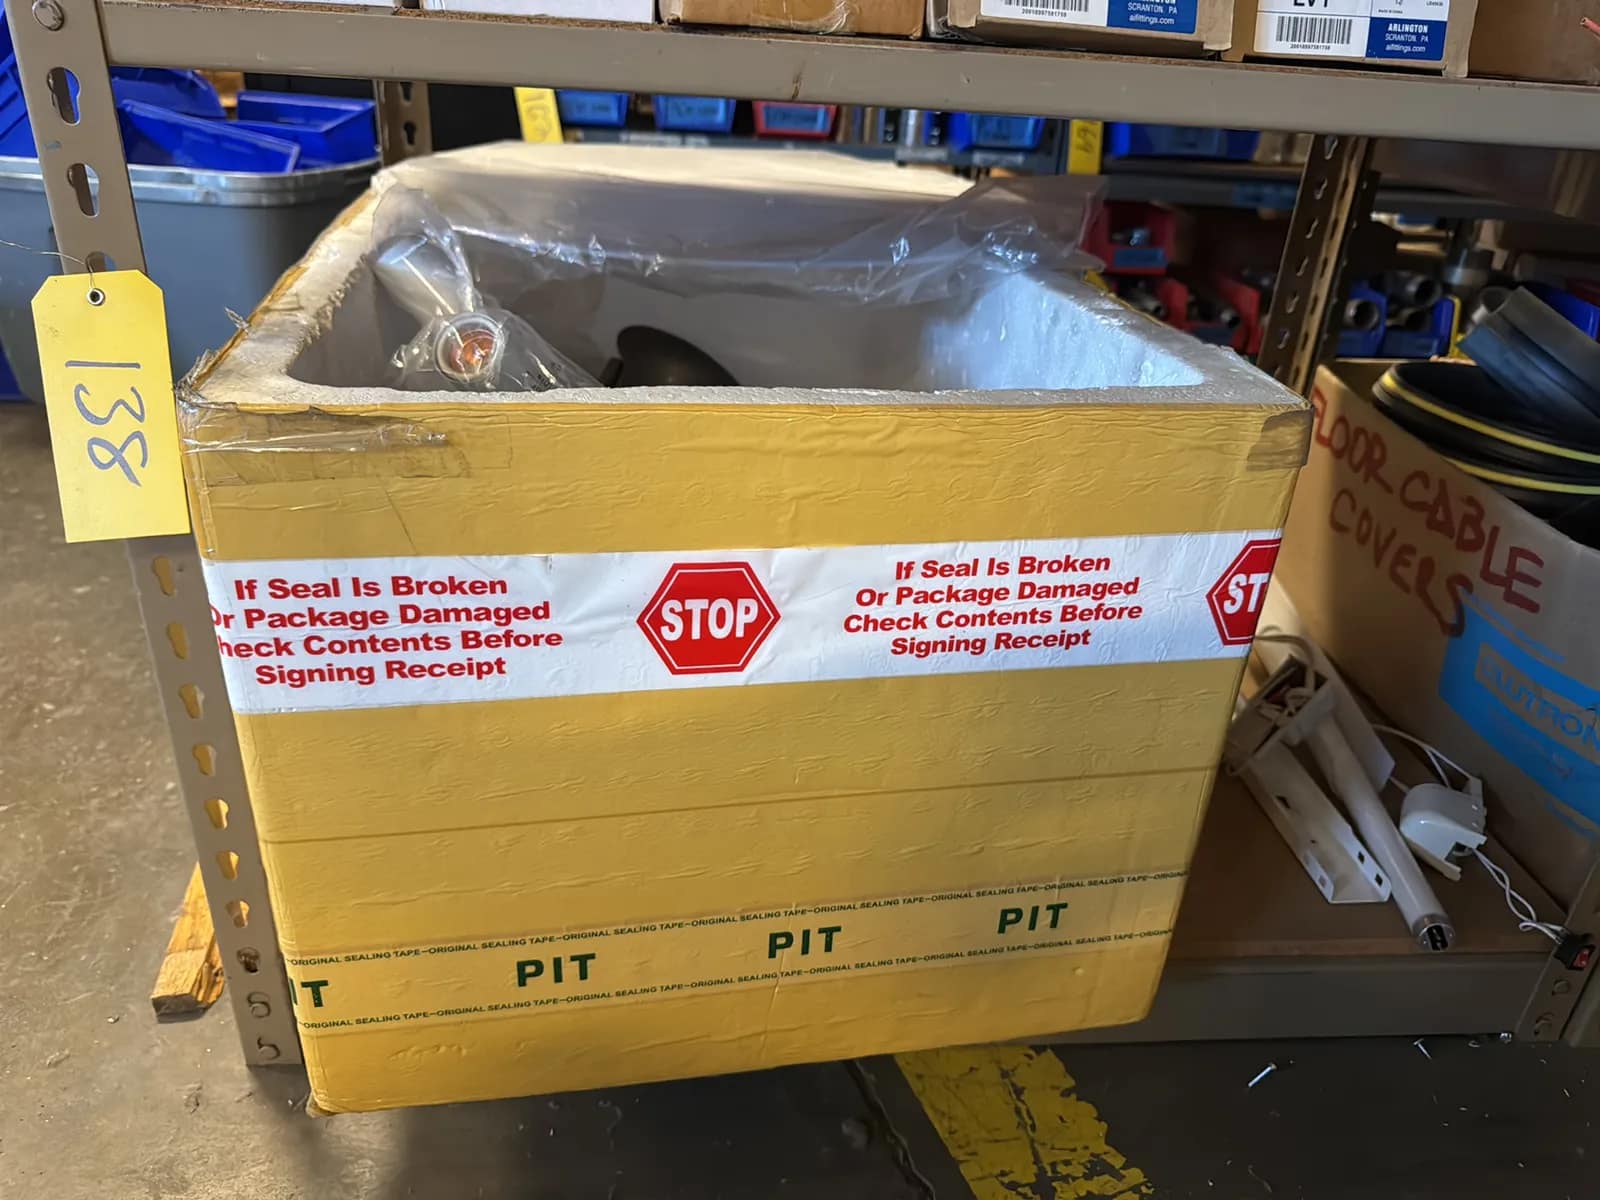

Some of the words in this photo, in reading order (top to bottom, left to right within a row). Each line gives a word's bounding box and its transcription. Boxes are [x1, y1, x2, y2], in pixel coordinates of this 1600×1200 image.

[1387, 23, 1429, 33] ARLINGTON
[65, 359, 148, 487] 138
[1398, 469, 1545, 615] CABLE
[895, 559, 917, 580] If
[921, 557, 978, 579] Seal
[987, 555, 1010, 577] Is
[1019, 554, 1111, 575] Broken
[1330, 487, 1474, 638] COVERS
[234, 579, 258, 600] If
[268, 577, 341, 600] Seal
[352, 576, 382, 597] Is
[391, 575, 508, 597] Broken
[855, 588, 890, 608] Or
[894, 583, 1010, 609] Package
[1018, 577, 1139, 602] Damaged
[243, 607, 390, 630] Package
[399, 601, 550, 628] Damaged
[660, 598, 759, 642] STOP
[843, 612, 929, 633] Check
[936, 606, 1053, 630] Contents
[1060, 602, 1143, 622] Before
[303, 632, 451, 656] Contents
[461, 630, 563, 649] Before
[891, 634, 987, 659] Signing
[993, 628, 1092, 653] Receipt
[256, 662, 375, 688] Signing
[385, 656, 507, 680] Receipt
[344, 950, 390, 963] SEALING
[481, 936, 526, 949] SEALING
[613, 923, 656, 936] SEALING
[740, 910, 780, 923] SEALING
[859, 898, 899, 910] SEALING
[997, 902, 1069, 934] PIT
[768, 925, 842, 959] PIT
[516, 952, 597, 987] PIT
[355, 1012, 401, 1025] SEALING
[487, 999, 530, 1012] SEALING
[615, 984, 656, 998] SEALING
[738, 970, 778, 984] SEALING
[854, 957, 893, 970] SEALING
